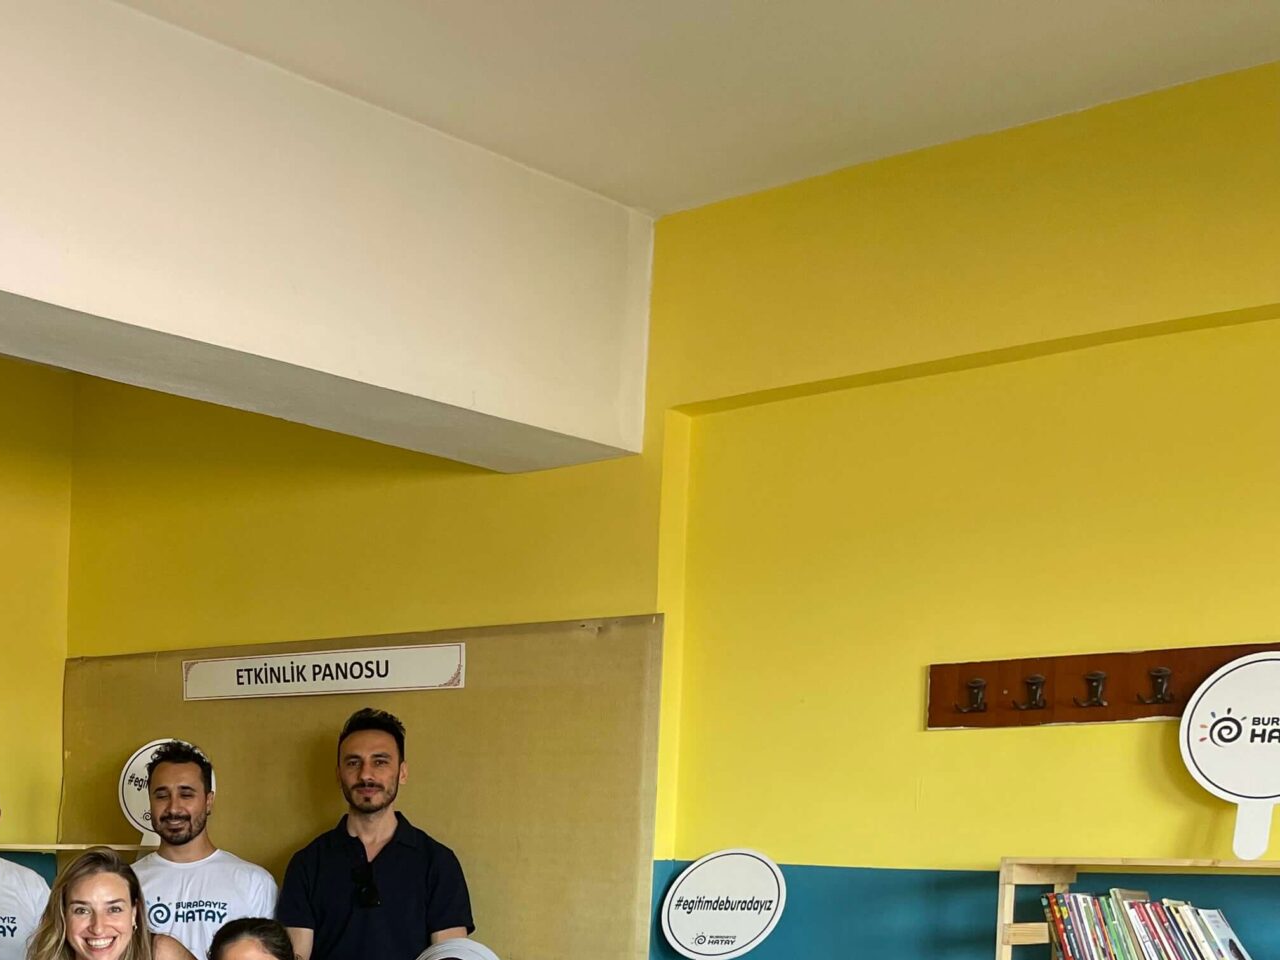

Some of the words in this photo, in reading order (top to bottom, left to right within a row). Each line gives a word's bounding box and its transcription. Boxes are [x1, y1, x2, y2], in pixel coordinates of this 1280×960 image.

[235, 660, 308, 686] ETKİNLİK
[311, 659, 390, 682] PANOSU
[175, 899, 228, 911] BURADAYIZ
[174, 908, 228, 924] HATAY
